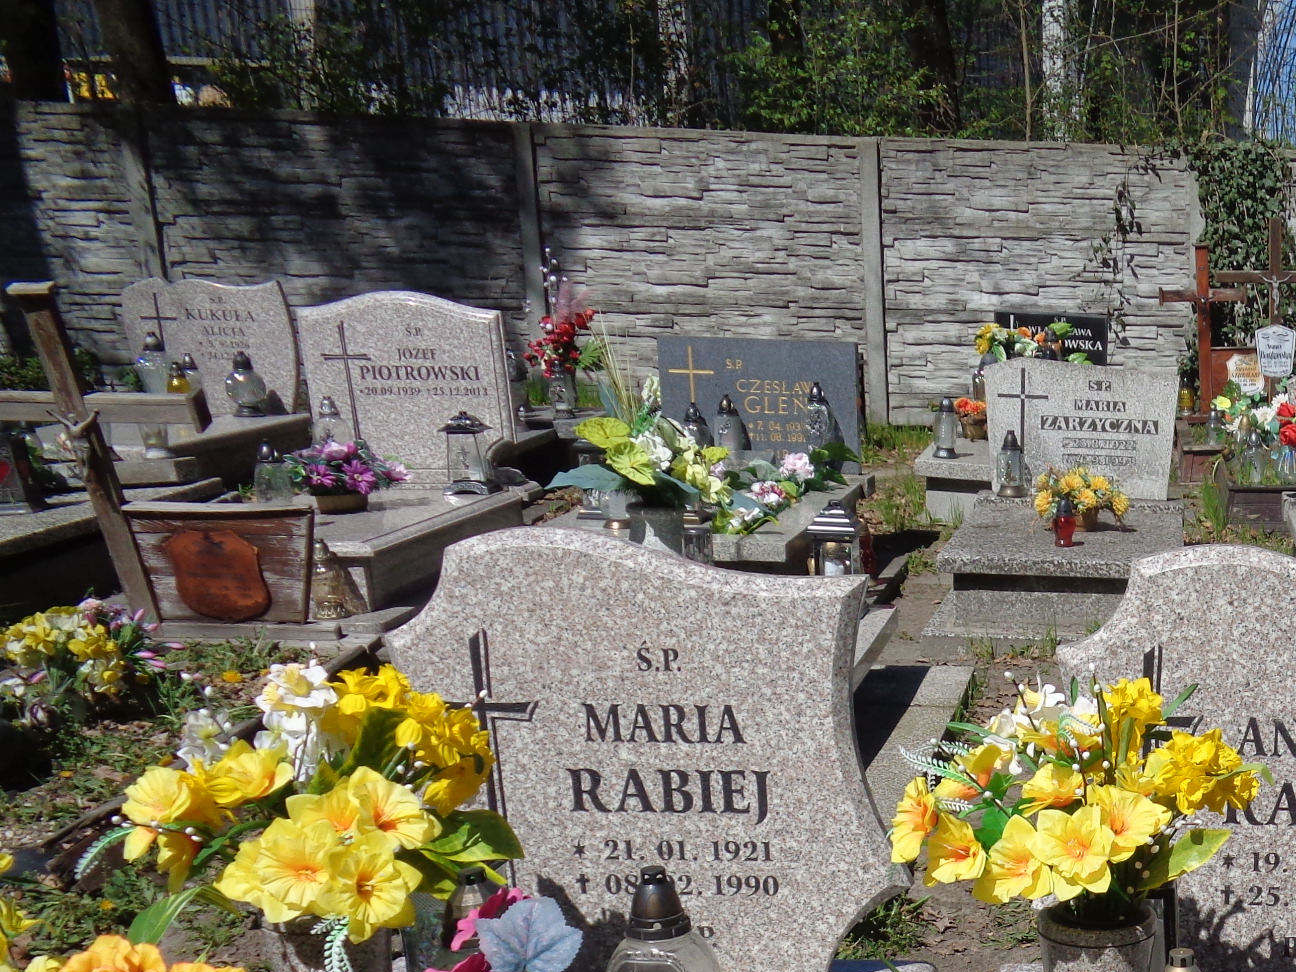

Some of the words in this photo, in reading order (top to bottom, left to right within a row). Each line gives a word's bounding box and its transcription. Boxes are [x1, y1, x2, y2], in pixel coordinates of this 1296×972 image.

[185, 308, 256, 322] KUKUŁA
[360, 365, 481, 381] PIOTROWSKI
[1075, 400, 1125, 412] MARIA
[1042, 415, 1158, 435] ZARZYCZNA
[637, 640, 682, 672] Ś.P.
[582, 702, 747, 745] MARIA
[566, 768, 771, 825] RABIEJ
[604, 839, 645, 861] 21.
[657, 840, 698, 861] 01.
[712, 840, 774, 862] 1921
[1251, 852, 1288, 874] 19.
[604, 873, 640, 896] 08
[714, 874, 780, 897] 1990
[1249, 885, 1289, 907] 25.
